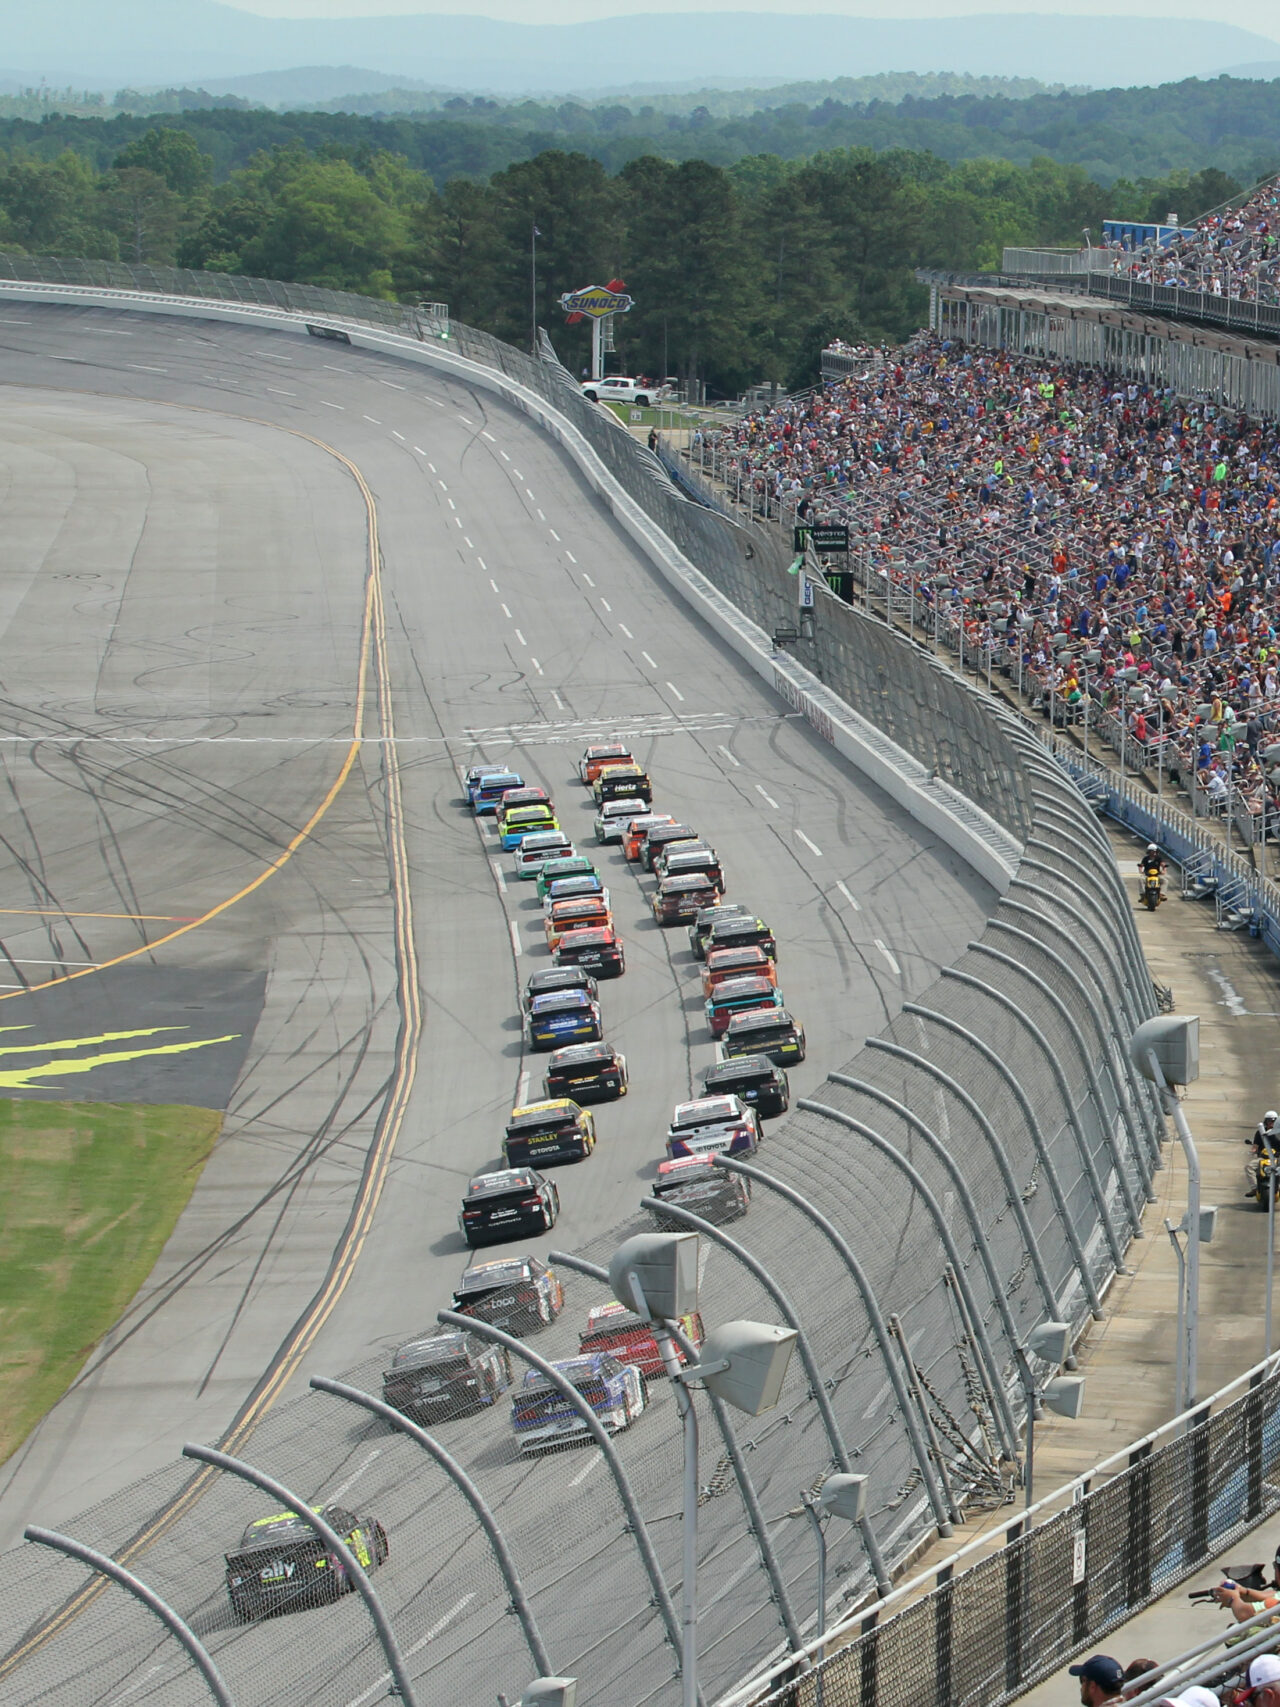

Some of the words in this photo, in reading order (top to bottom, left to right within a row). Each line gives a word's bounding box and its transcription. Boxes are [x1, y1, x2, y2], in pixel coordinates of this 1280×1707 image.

[570, 297, 626, 309] SUNOCO
[528, 1133, 558, 1145] STANLEY
[537, 1145, 561, 1154] TOYOTA
[703, 1142, 727, 1151] TOYOTA
[260, 1560, 295, 1580] ally
